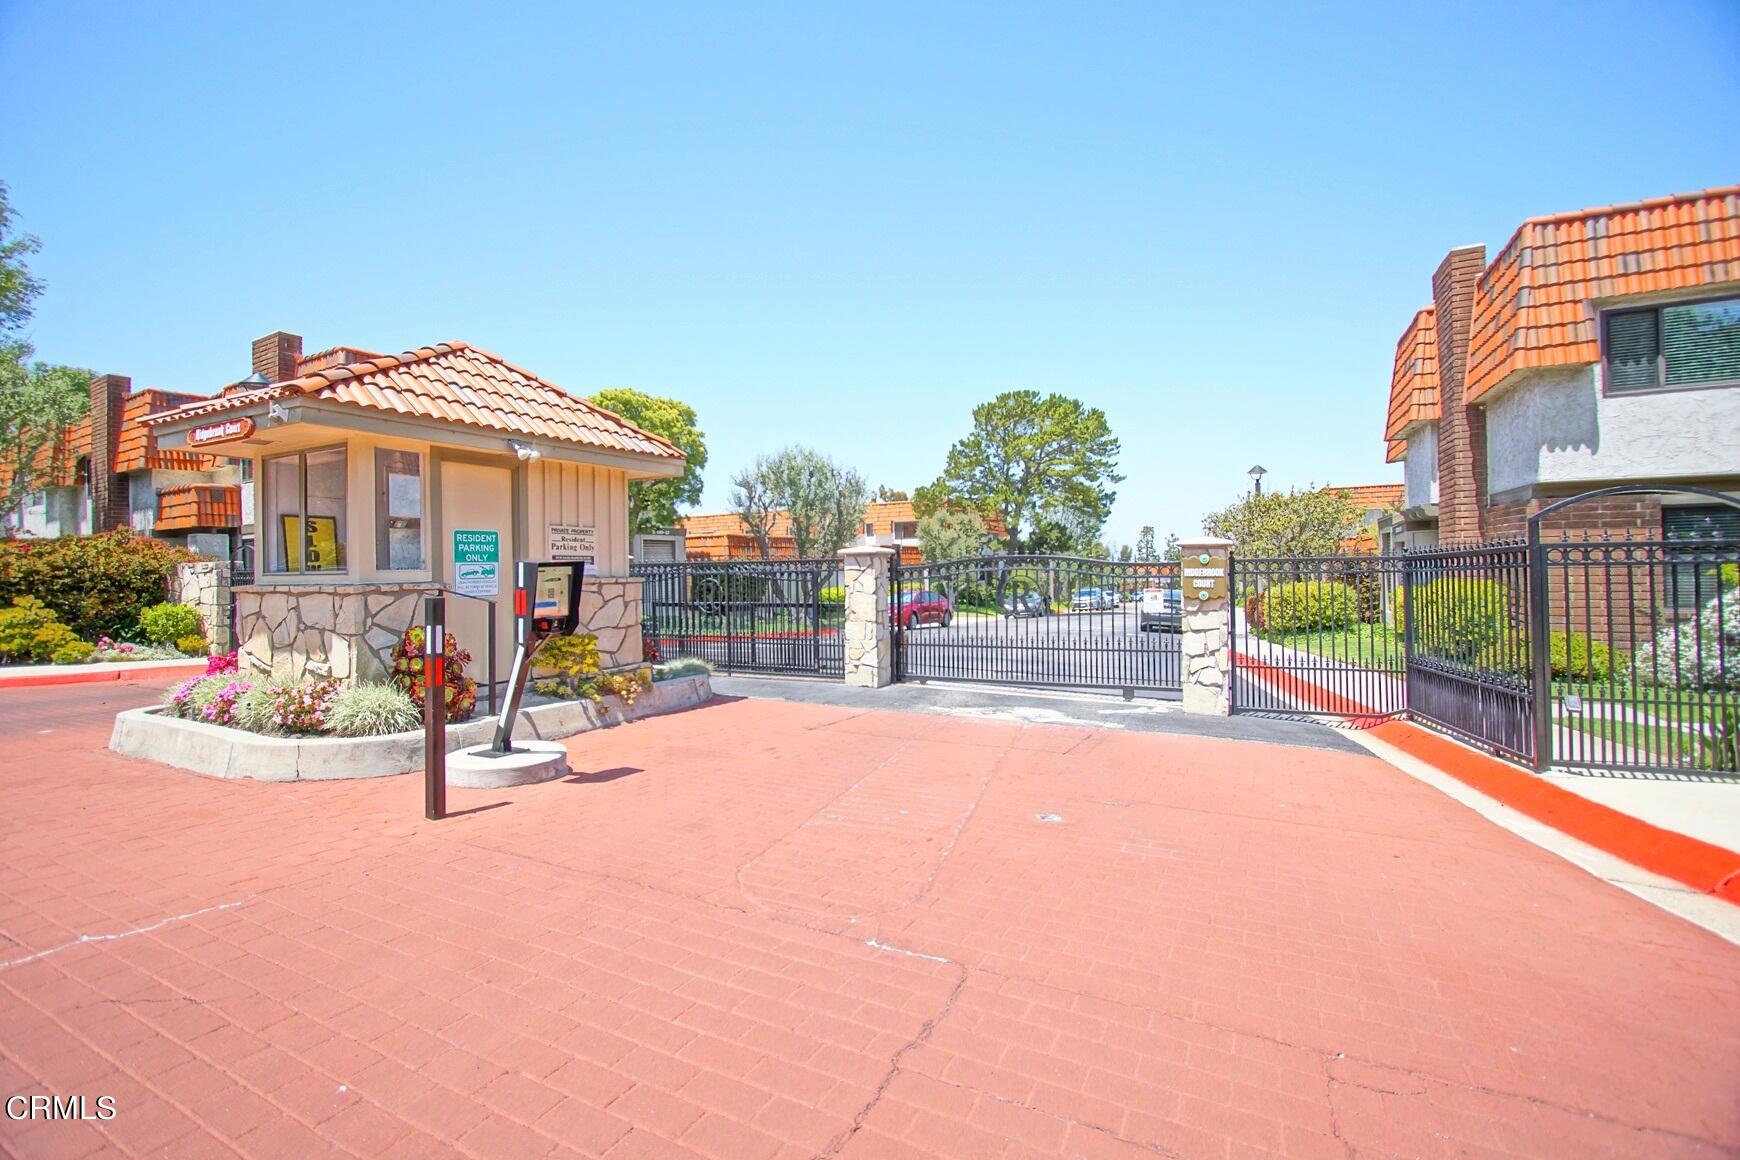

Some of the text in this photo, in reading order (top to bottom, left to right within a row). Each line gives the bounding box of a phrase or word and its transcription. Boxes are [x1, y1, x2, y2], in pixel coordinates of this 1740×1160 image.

[225, 422, 241, 435] Court
[456, 534, 496, 542] RESIDENT
[458, 543, 495, 551] PARKING
[551, 543, 594, 552] Parking Only
[465, 553, 488, 561] ONLY
[1184, 567, 1225, 577] RIDGEBROOK
[1193, 579, 1215, 588] COURT
